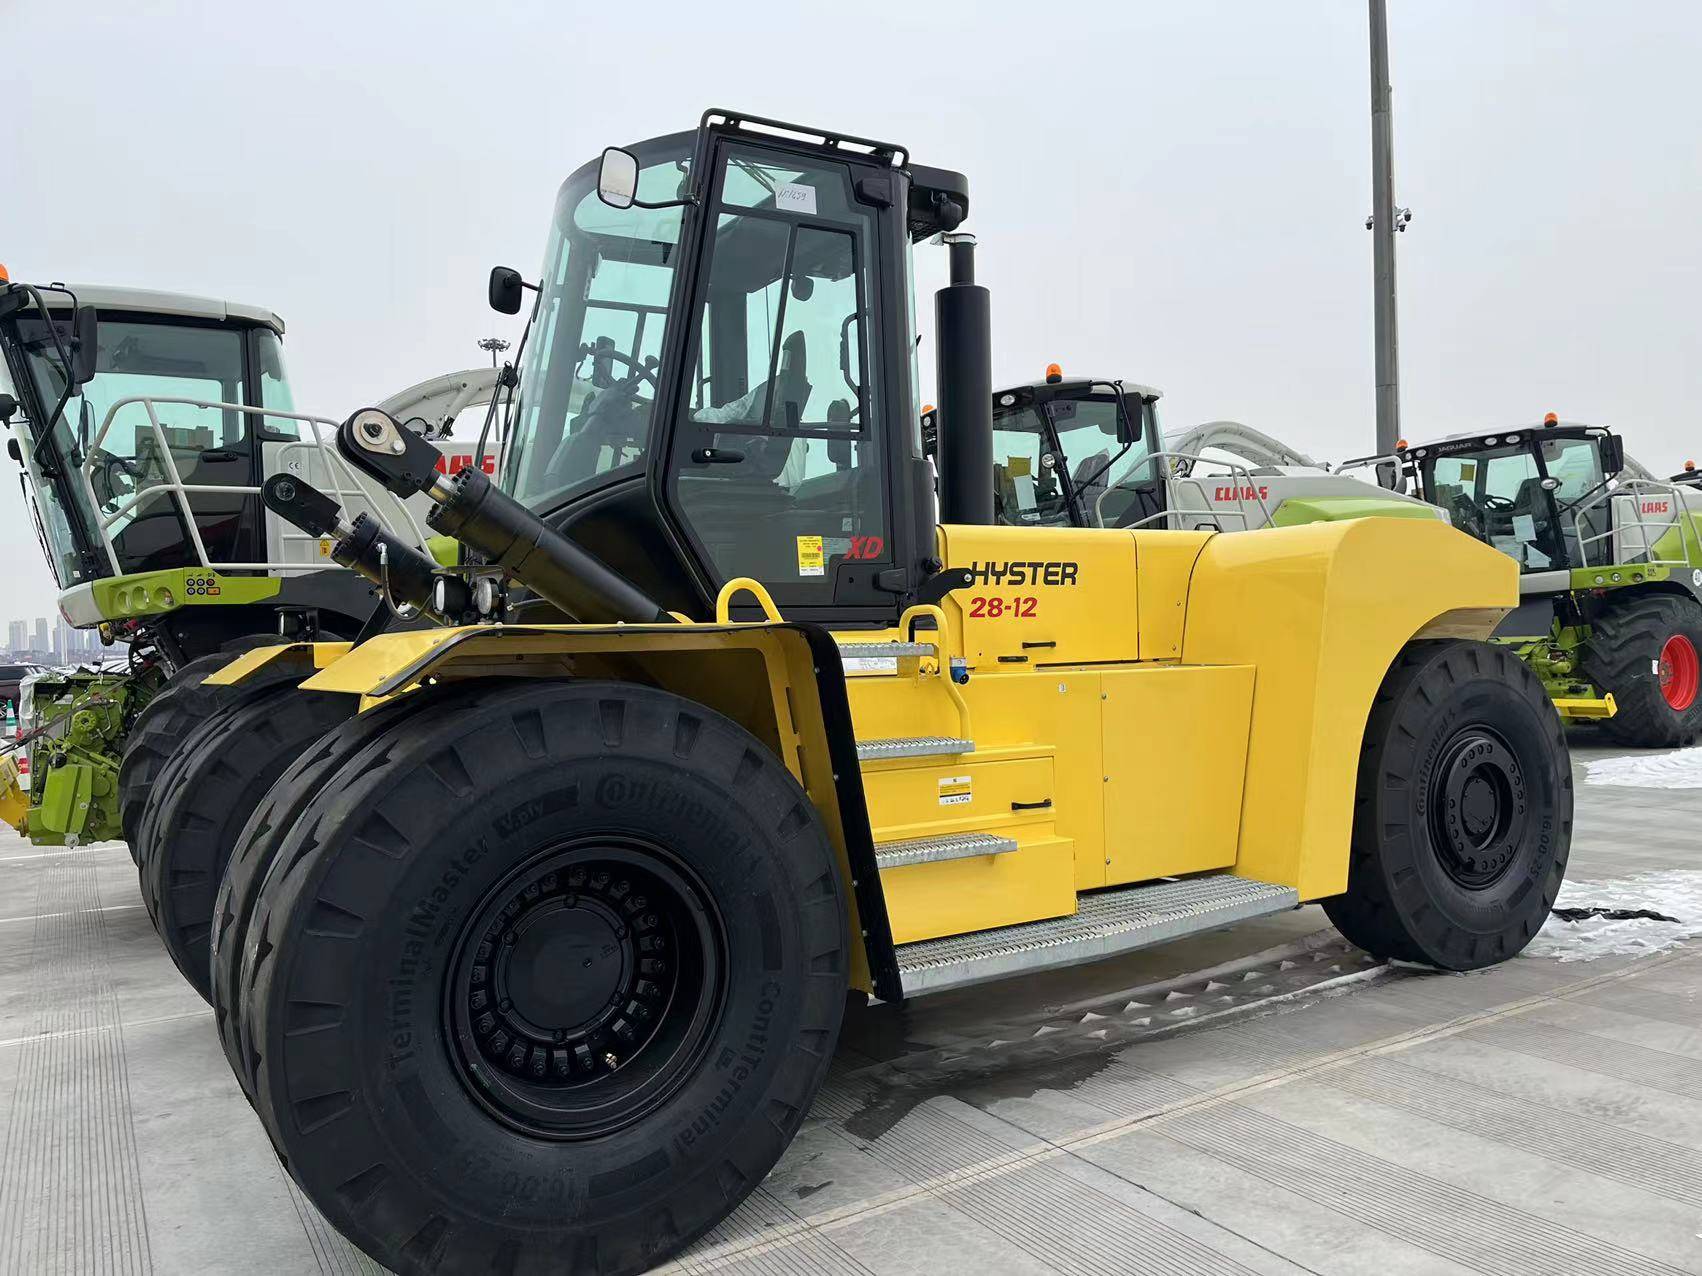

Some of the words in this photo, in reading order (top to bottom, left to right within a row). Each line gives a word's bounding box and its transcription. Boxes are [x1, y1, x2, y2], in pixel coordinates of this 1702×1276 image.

[1215, 486, 1268, 502] CLAAS
[843, 536, 884, 561] XD
[970, 561, 1079, 586] HYSTER
[969, 597, 1038, 618] 28-12
[672, 979, 783, 1160] ContiTerminal
